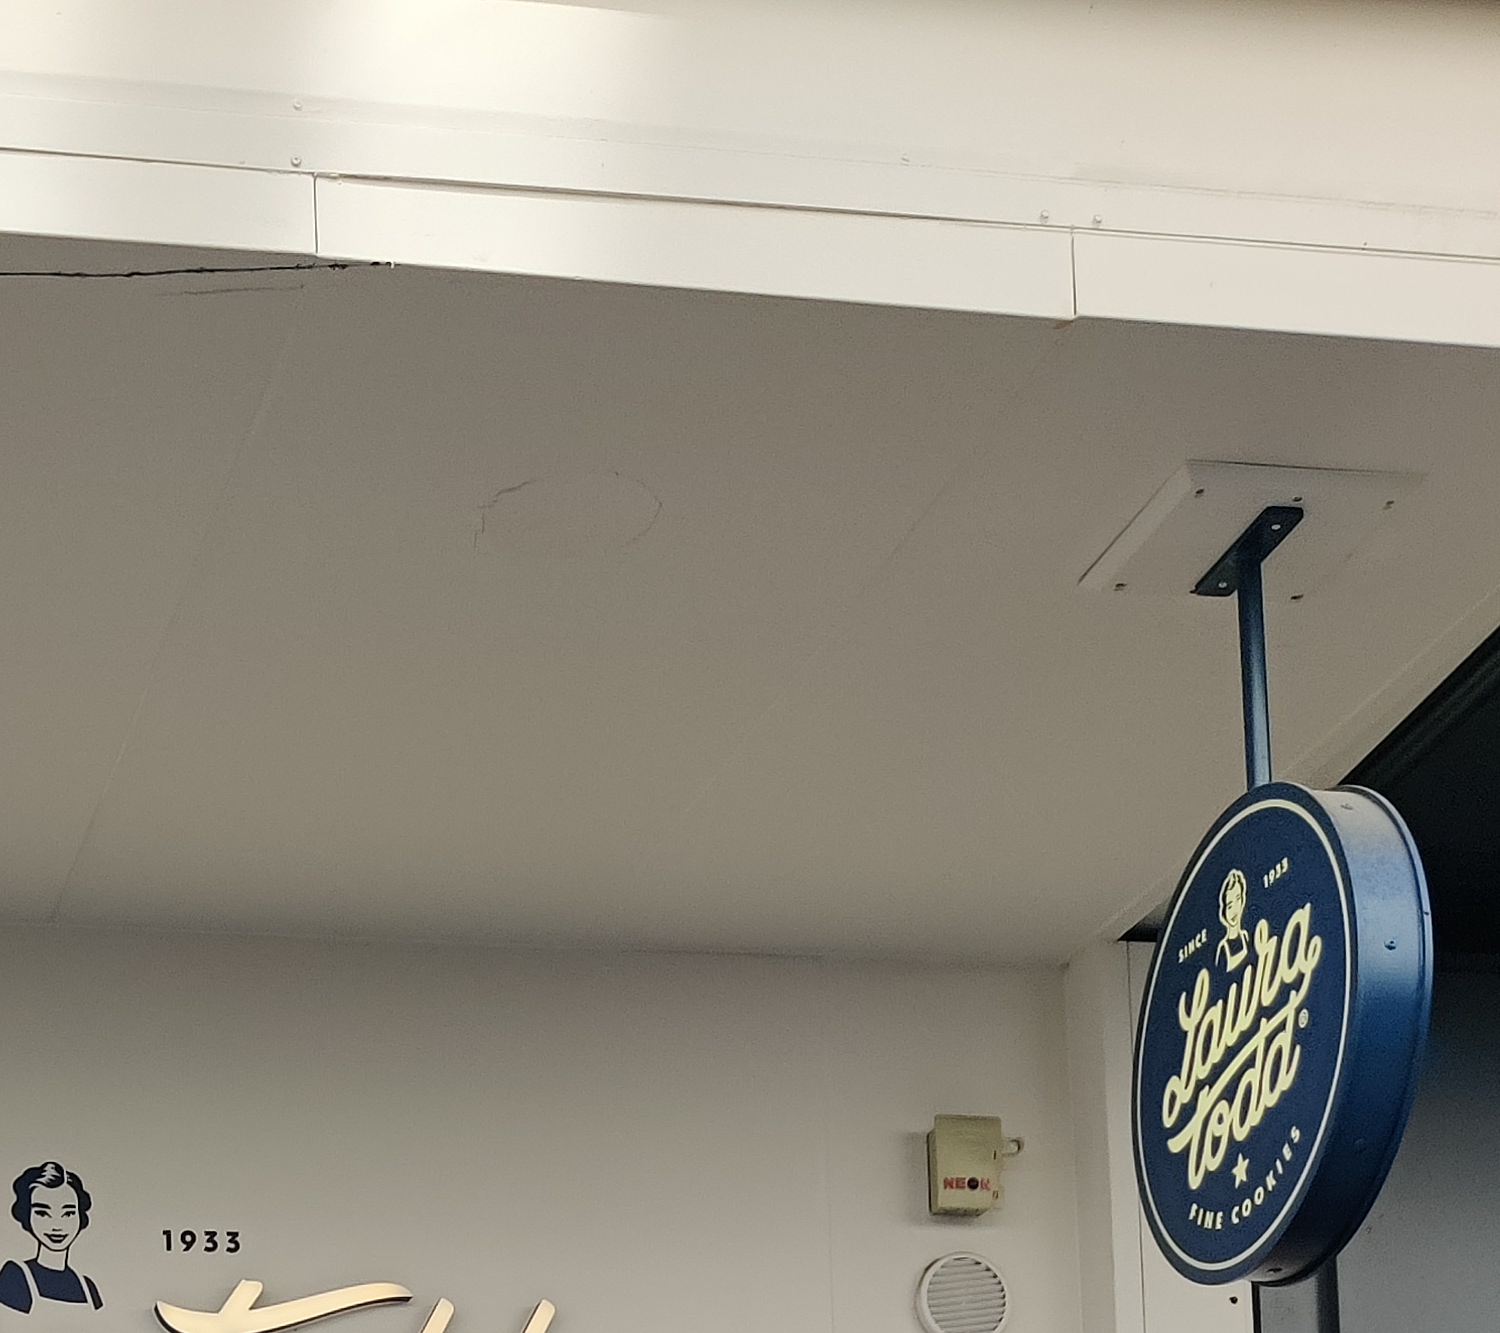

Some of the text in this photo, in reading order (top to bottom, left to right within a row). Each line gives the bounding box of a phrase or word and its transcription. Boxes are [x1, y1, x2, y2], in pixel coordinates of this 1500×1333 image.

[1262, 857, 1289, 889] 1933
[1178, 928, 1208, 964] SINCE
[1161, 902, 1322, 1129] Laura
[1167, 1006, 1301, 1191] todd
[1188, 1125, 1301, 1230] FINE COOKIES
[162, 1229, 241, 1254] 1933
